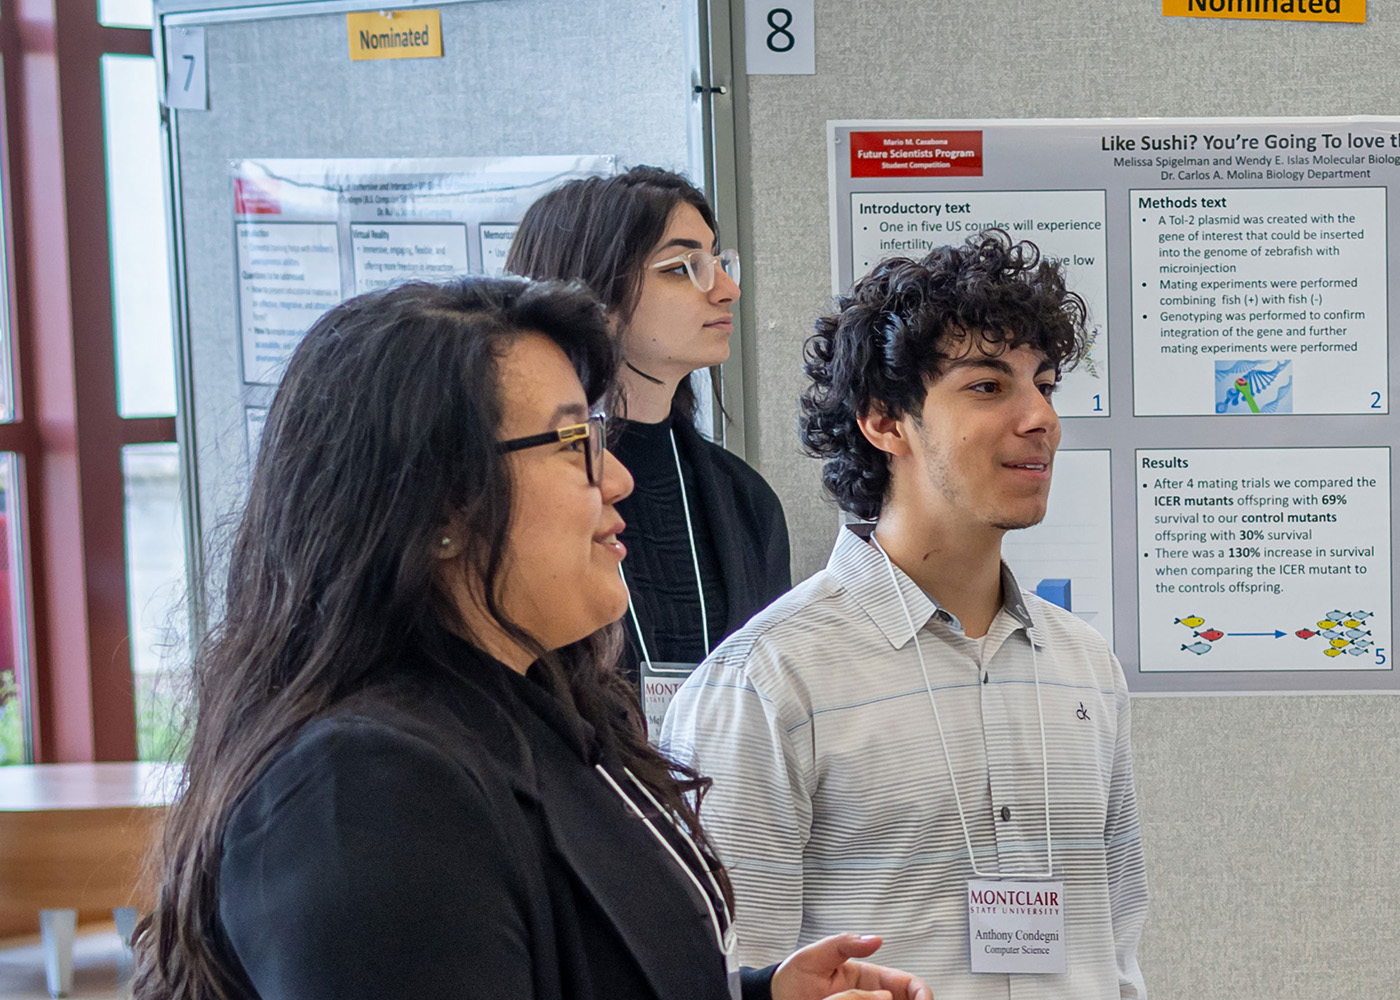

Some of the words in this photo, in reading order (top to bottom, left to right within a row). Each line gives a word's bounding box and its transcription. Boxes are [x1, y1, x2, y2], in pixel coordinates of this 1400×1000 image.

[358, 24, 430, 51] Nominated
[766, 7, 796, 54] 8
[181, 54, 195, 93] 7
[1102, 135, 1136, 151] Like
[1141, 134, 1198, 151] Sushi?
[1265, 134, 1317, 152] Going
[1321, 134, 1342, 149] To
[1348, 133, 1385, 148] love
[858, 149, 888, 159] Future
[890, 149, 933, 158] Scientists
[935, 148, 975, 160] Program
[1114, 157, 1153, 167] Melissa
[1156, 156, 1210, 168] Spigelman
[1213, 156, 1232, 166] and
[1235, 155, 1272, 167] Wendy
[1275, 155, 1284, 165] E.
[1287, 155, 1310, 165] Islas
[1313, 154, 1366, 165] Molecular
[1161, 171, 1175, 181] Dr.
[1178, 170, 1210, 181] Carlos
[1213, 170, 1224, 180] A.
[1227, 169, 1263, 180] Molina
[1266, 169, 1305, 181] Biology
[1307, 169, 1371, 181] Department
[860, 202, 942, 216] Introductory
[945, 203, 971, 214] text
[1139, 196, 1198, 209] Methods
[1201, 197, 1227, 208] text
[879, 221, 904, 232] One
[907, 221, 918, 232] in
[921, 220, 943, 232] five
[946, 220, 962, 232] US
[1013, 219, 1033, 231] will
[1037, 220, 1102, 233] experience
[1158, 216, 1167, 225] A
[1169, 215, 1195, 225] Tol-2
[1198, 214, 1240, 227] plasmid
[1243, 216, 1264, 224] was
[1267, 214, 1308, 224] created
[1310, 213, 1334, 224] with
[1337, 213, 1356, 223] the
[880, 238, 932, 252] infertility
[1074, 254, 1095, 266] low
[1093, 395, 1103, 411] 1
[1371, 391, 1381, 408] 2
[1142, 457, 1189, 469] Results
[1154, 496, 1181, 507] ICER
[1184, 496, 1234, 506] mutants
[1237, 494, 1289, 508] offspring
[1292, 494, 1318, 505] with
[1322, 494, 1347, 505] 69%
[1375, 648, 1386, 665] 5
[970, 890, 1059, 906] MONTCLAIR
[1002, 907, 1059, 915] UNIVERSITY
[975, 929, 1013, 944] Anthony
[1015, 930, 1059, 944] Condegni
[984, 945, 1020, 956] Computer
[1021, 945, 1050, 955] Science
